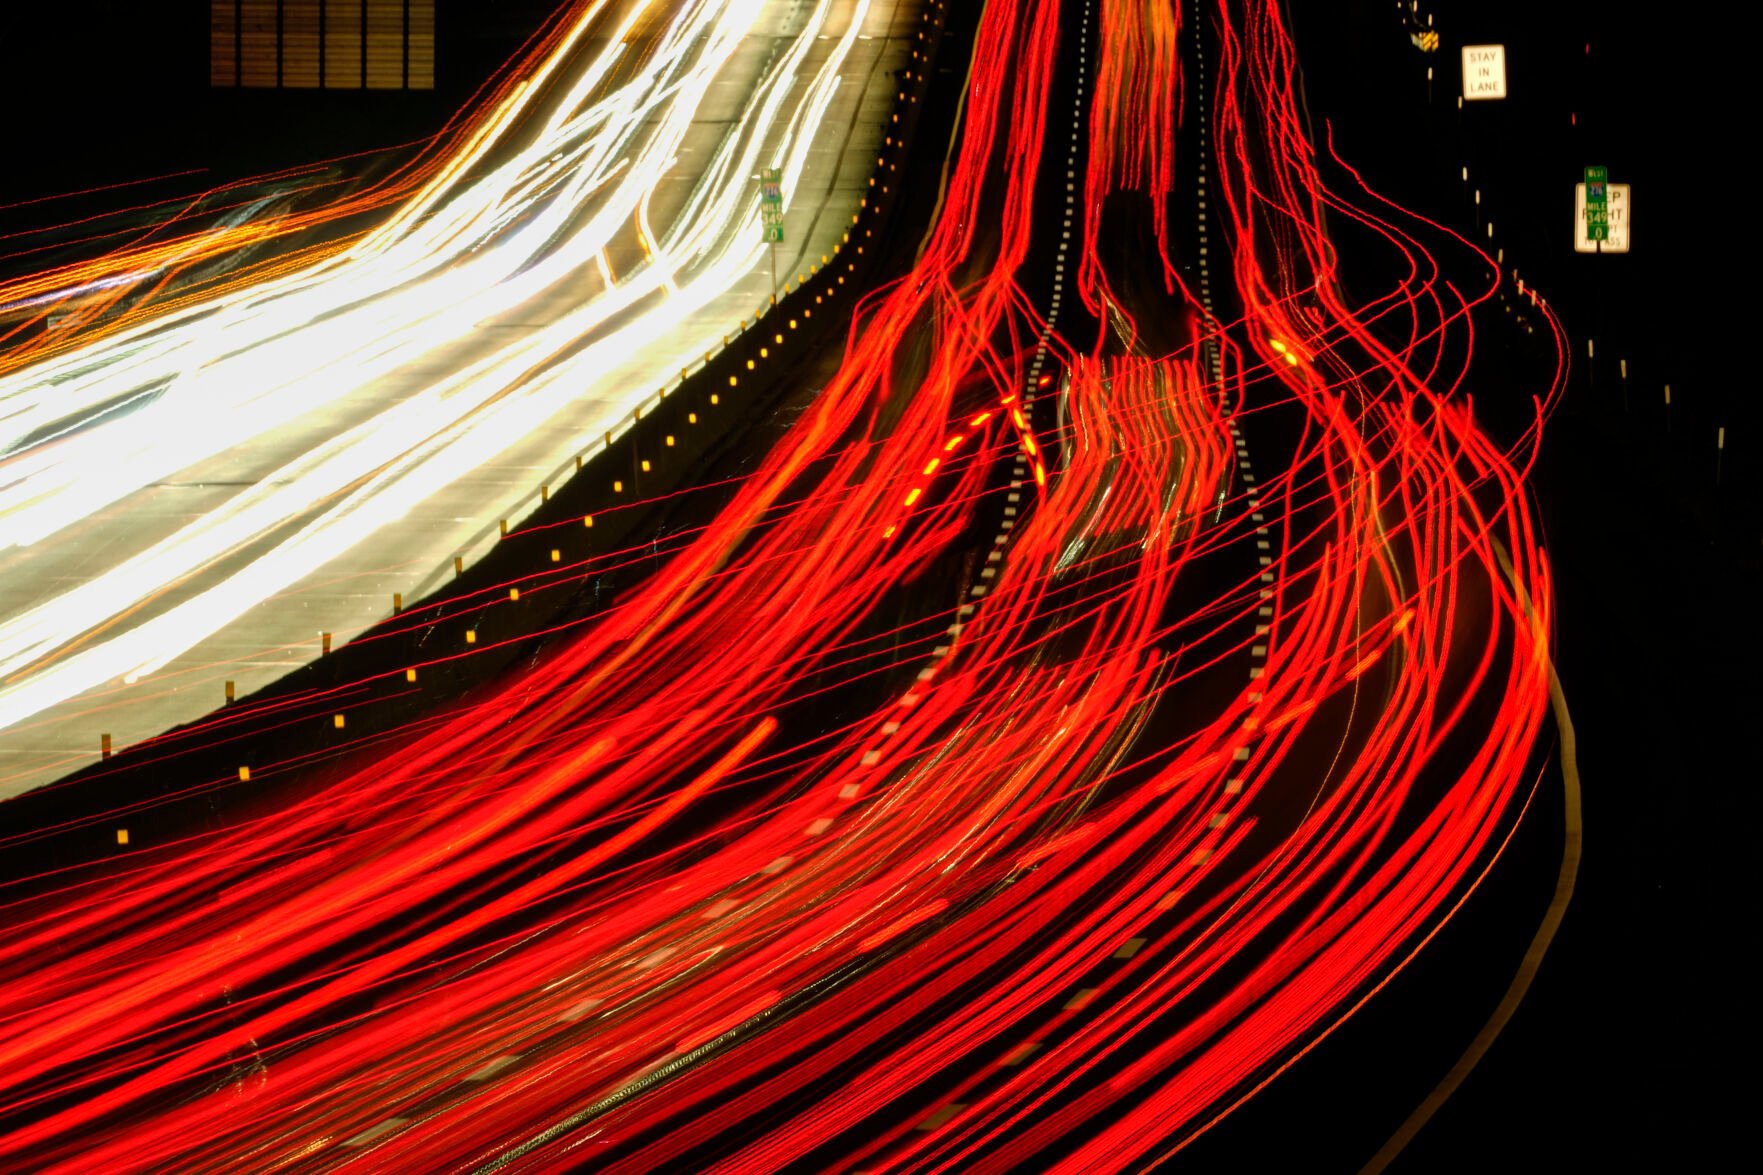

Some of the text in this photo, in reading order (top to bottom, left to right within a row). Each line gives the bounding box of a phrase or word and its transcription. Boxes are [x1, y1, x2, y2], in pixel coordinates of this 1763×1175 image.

[1470, 51, 1496, 63] STAY
[1478, 67, 1489, 77] IN
[1470, 81, 1498, 92] LANE
[1587, 202, 1606, 211] MILE
[762, 213, 783, 224] 349
[1587, 210, 1607, 224] 349
